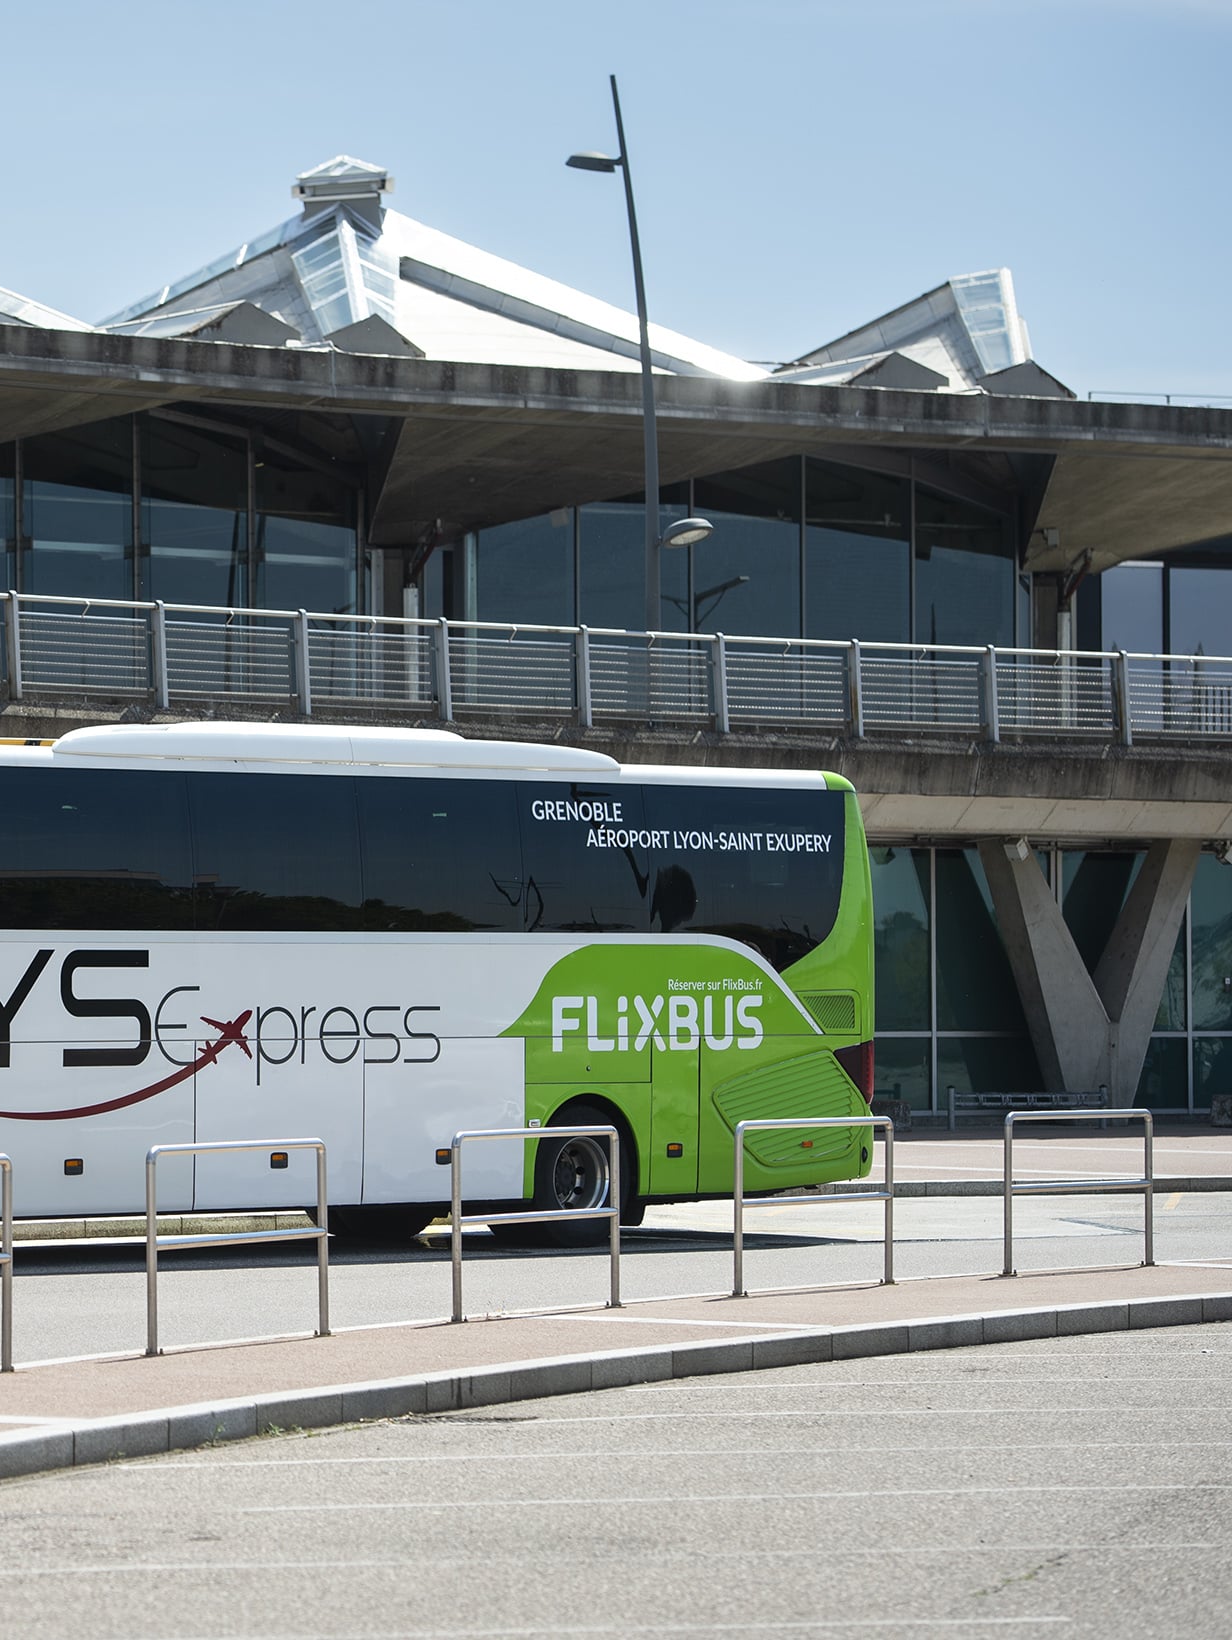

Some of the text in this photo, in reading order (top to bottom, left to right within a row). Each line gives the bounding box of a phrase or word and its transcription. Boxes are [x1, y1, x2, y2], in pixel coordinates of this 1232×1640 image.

[531, 800, 624, 822] GRENOBLE
[586, 825, 832, 852] AÉROPORT LYON-SAINT EXUPERY
[668, 979, 763, 991] Réserver sur FlixBus.fr
